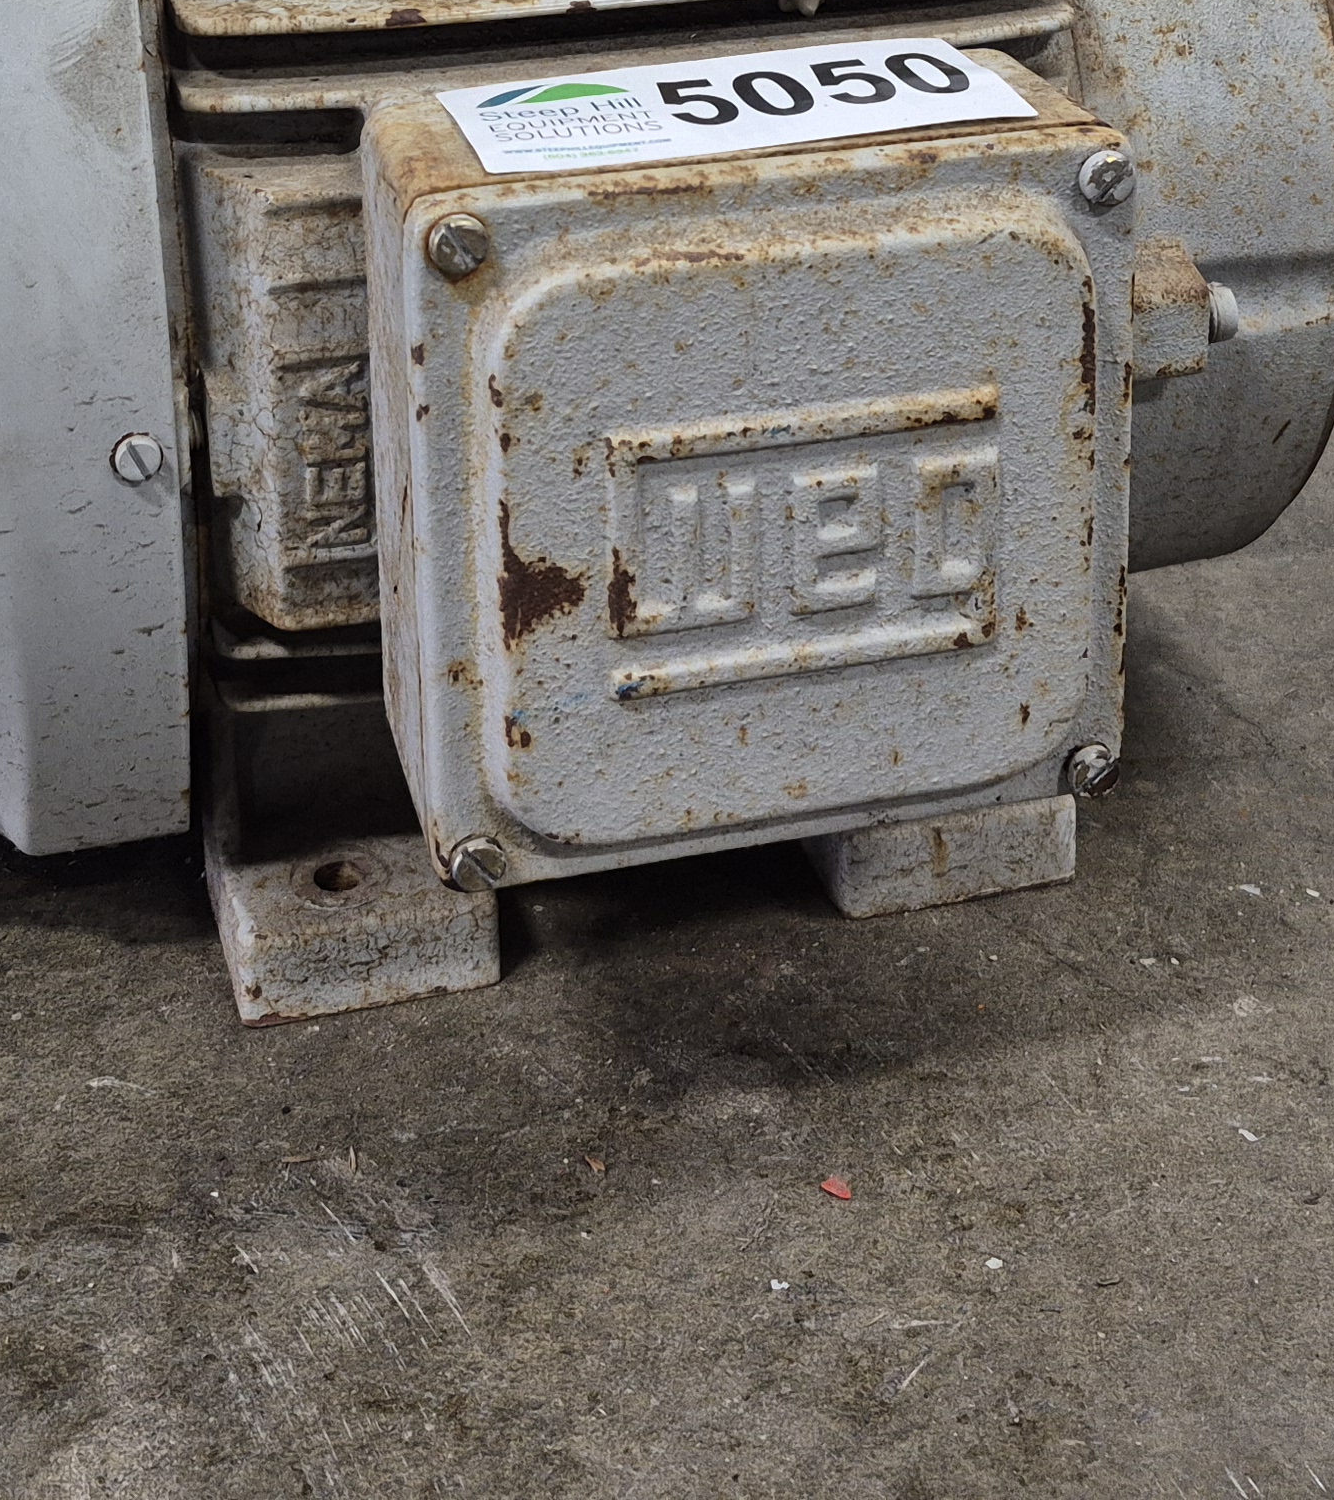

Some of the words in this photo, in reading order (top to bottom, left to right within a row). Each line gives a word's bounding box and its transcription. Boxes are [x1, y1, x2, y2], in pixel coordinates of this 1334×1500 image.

[656, 51, 970, 126] 5050
[478, 105, 580, 123] Steep
[589, 96, 643, 113] Hill
[488, 110, 654, 134] EQUIPMENT
[495, 120, 664, 143] SOLUTIONS
[297, 358, 371, 548] NEMA
